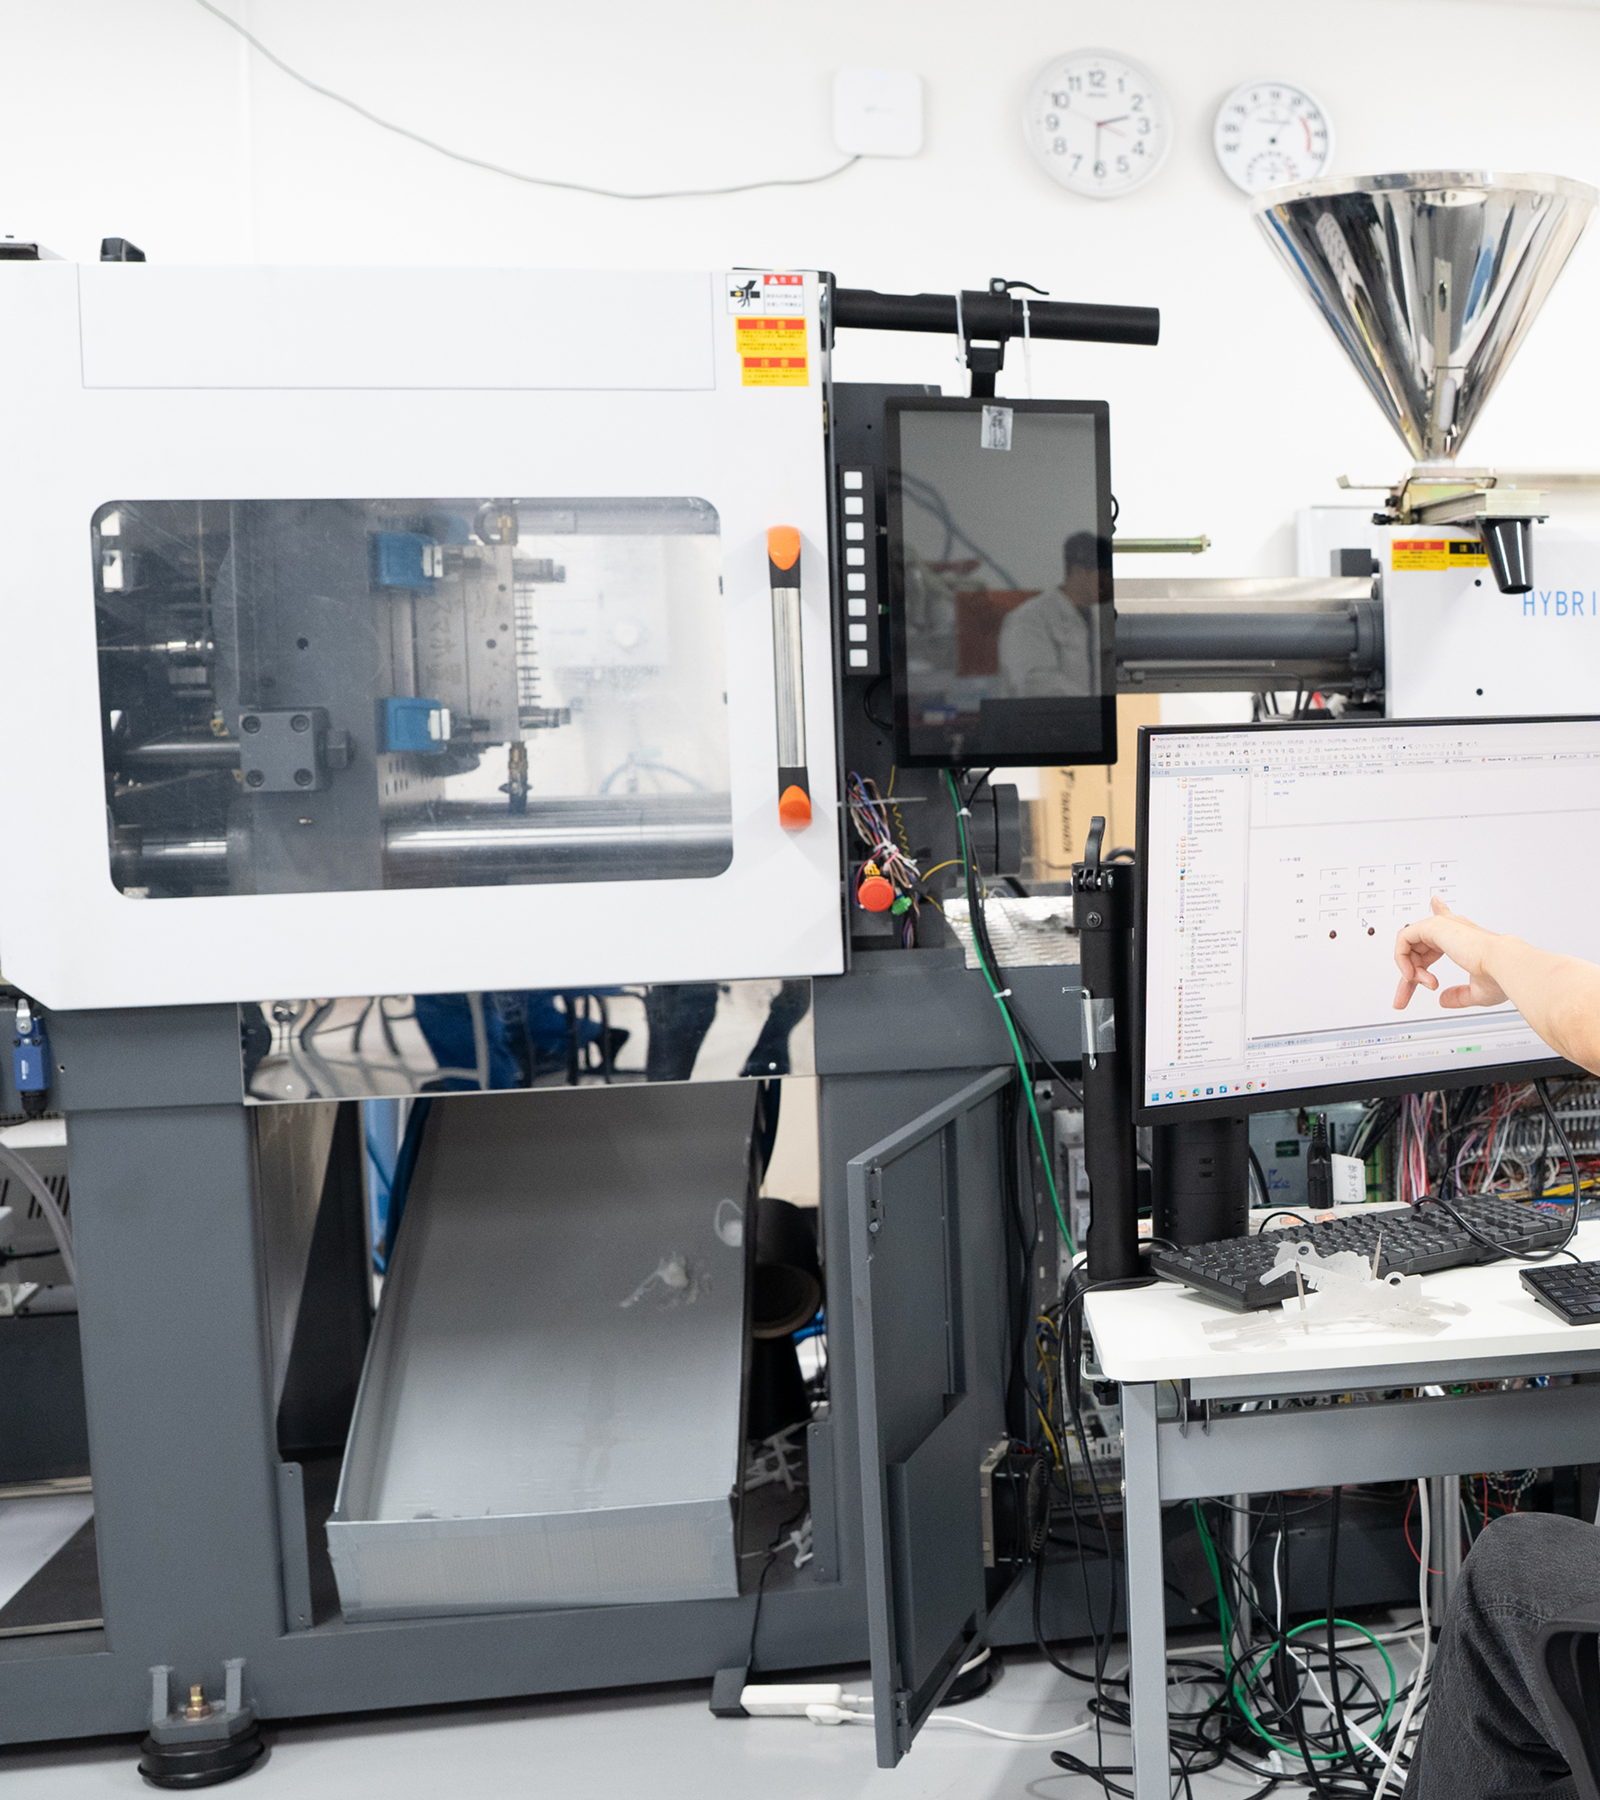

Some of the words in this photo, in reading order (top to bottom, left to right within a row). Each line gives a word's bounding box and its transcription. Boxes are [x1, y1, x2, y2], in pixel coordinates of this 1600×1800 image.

[1068, 76, 1082, 92] 11
[1088, 69, 1106, 88] 12
[1051, 90, 1070, 110] 10
[1130, 93, 1144, 112] 2
[1045, 113, 1060, 132] 9
[1137, 116, 1151, 135] 3
[1053, 136, 1067, 155] 8
[1093, 160, 1107, 179] 6
[1116, 154, 1130, 173] 5
